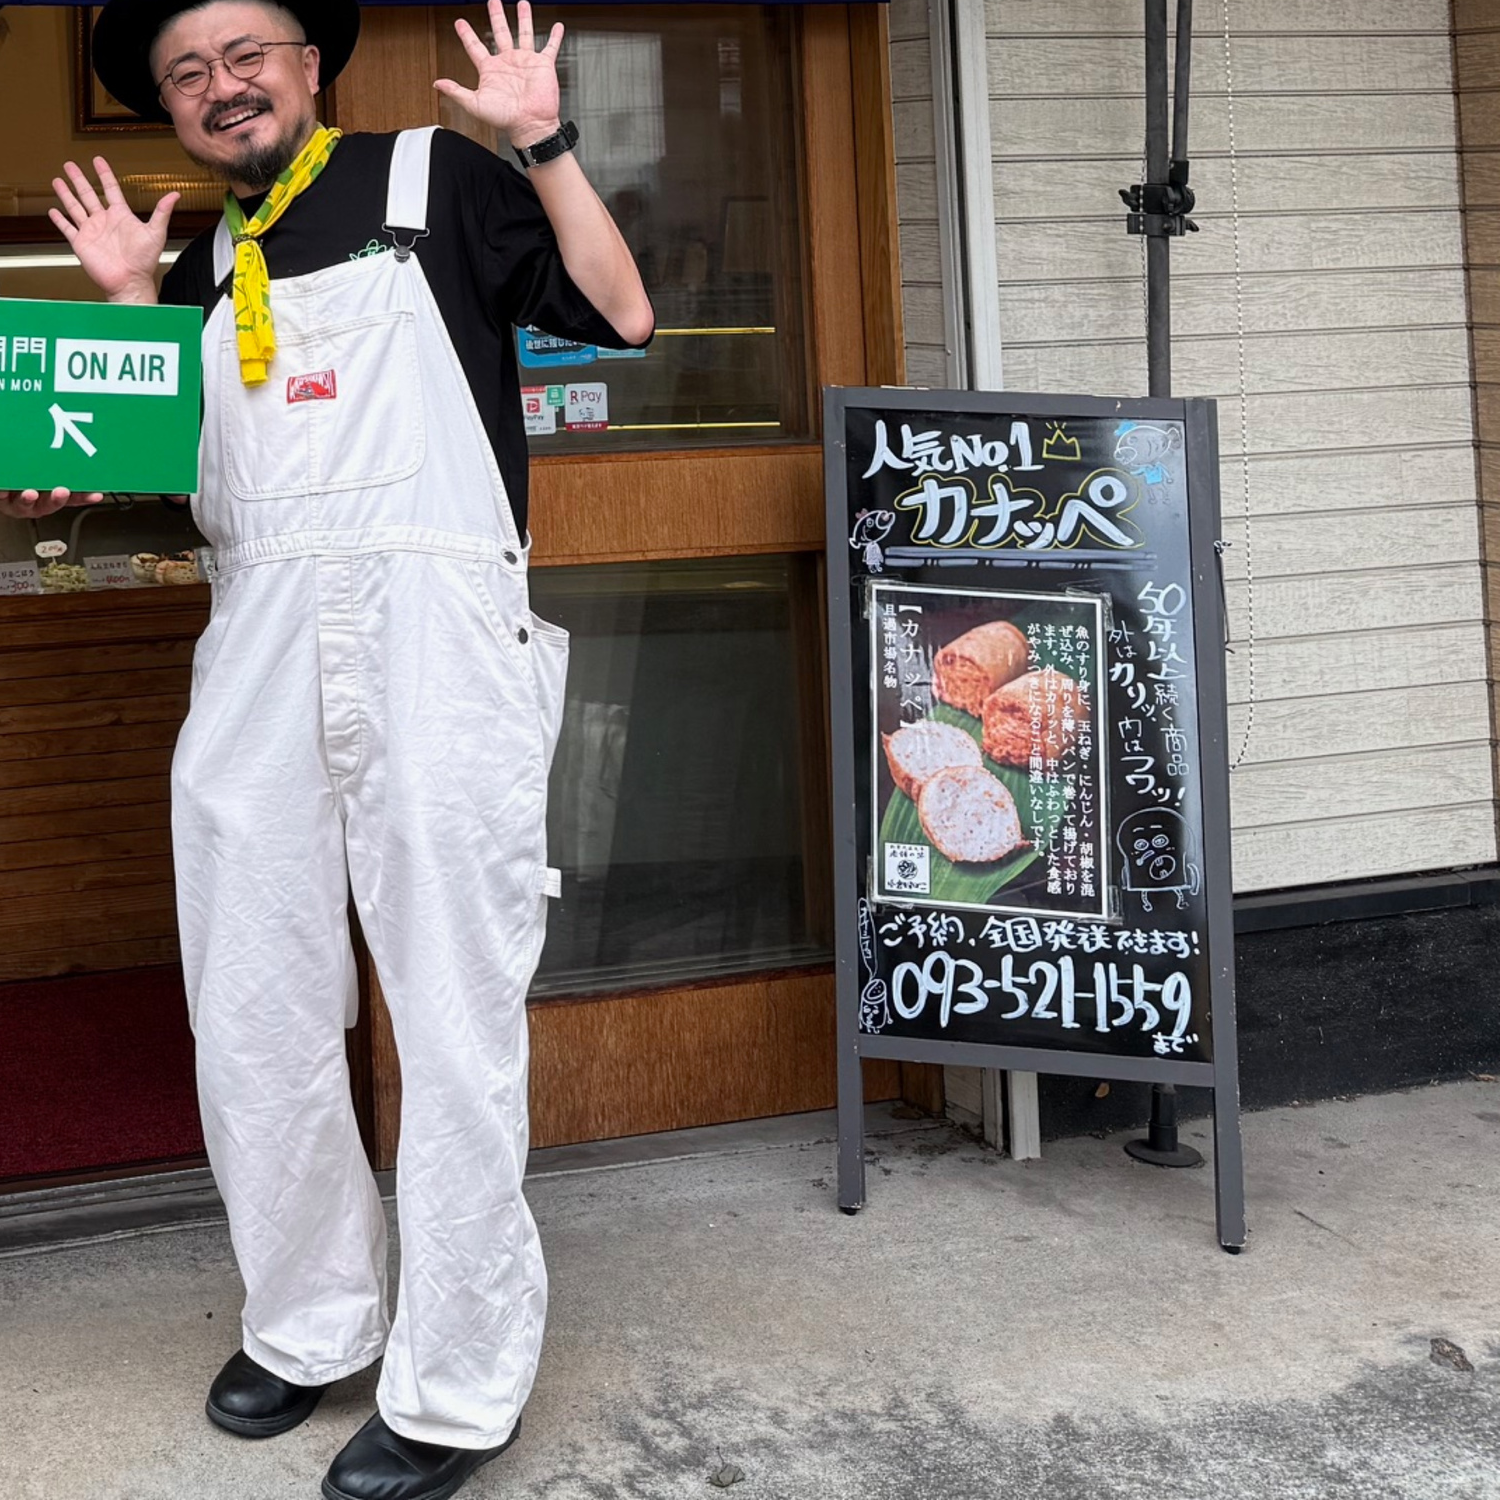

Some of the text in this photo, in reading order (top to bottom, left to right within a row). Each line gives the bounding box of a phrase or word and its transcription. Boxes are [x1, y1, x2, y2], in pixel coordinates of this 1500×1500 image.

[67, 351, 165, 382] ON AIR
[581, 390, 602, 403] Pay
[862, 420, 1045, 479] 人気No.1
[901, 476, 1134, 548] カナッペ
[891, 950, 1192, 1036] 093-521-1559
[1152, 1031, 1199, 1054] まで
